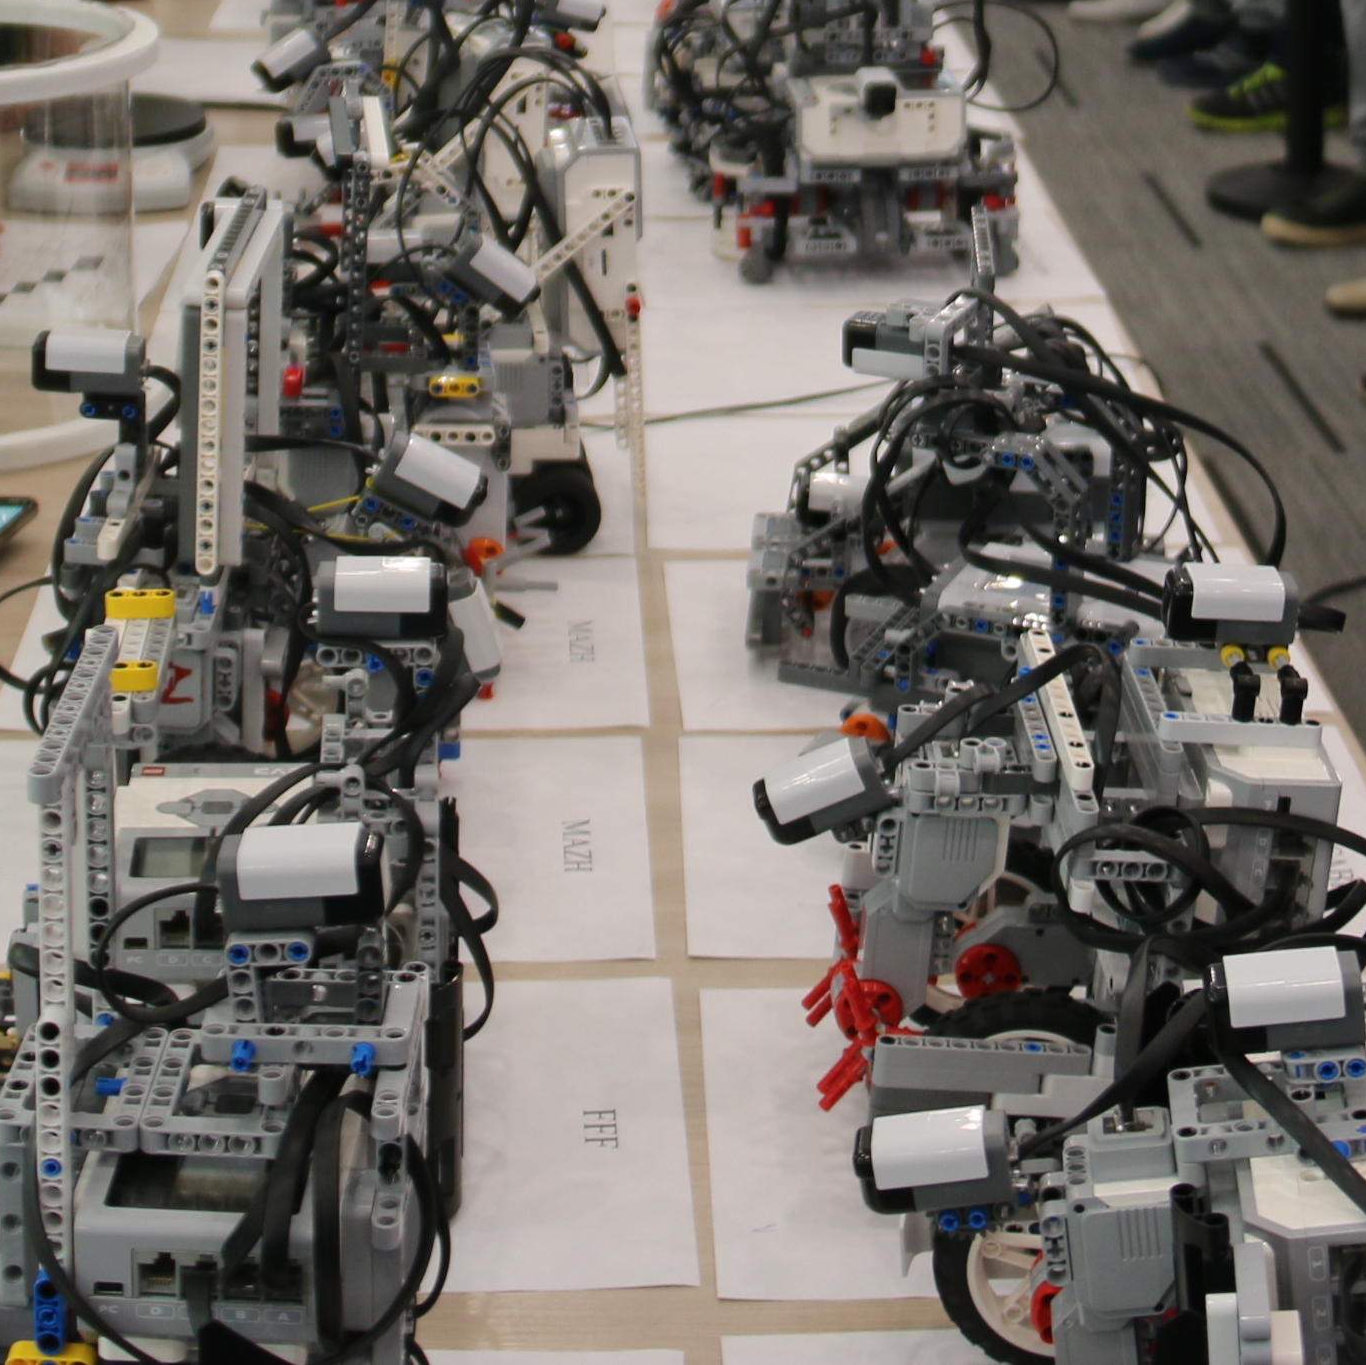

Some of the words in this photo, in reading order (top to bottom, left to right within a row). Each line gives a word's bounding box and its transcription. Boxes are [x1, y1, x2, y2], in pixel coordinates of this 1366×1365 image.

[562, 818, 592, 873] MAZH
[583, 1109, 619, 1150] FFF
[98, 1305, 118, 1314] PC
